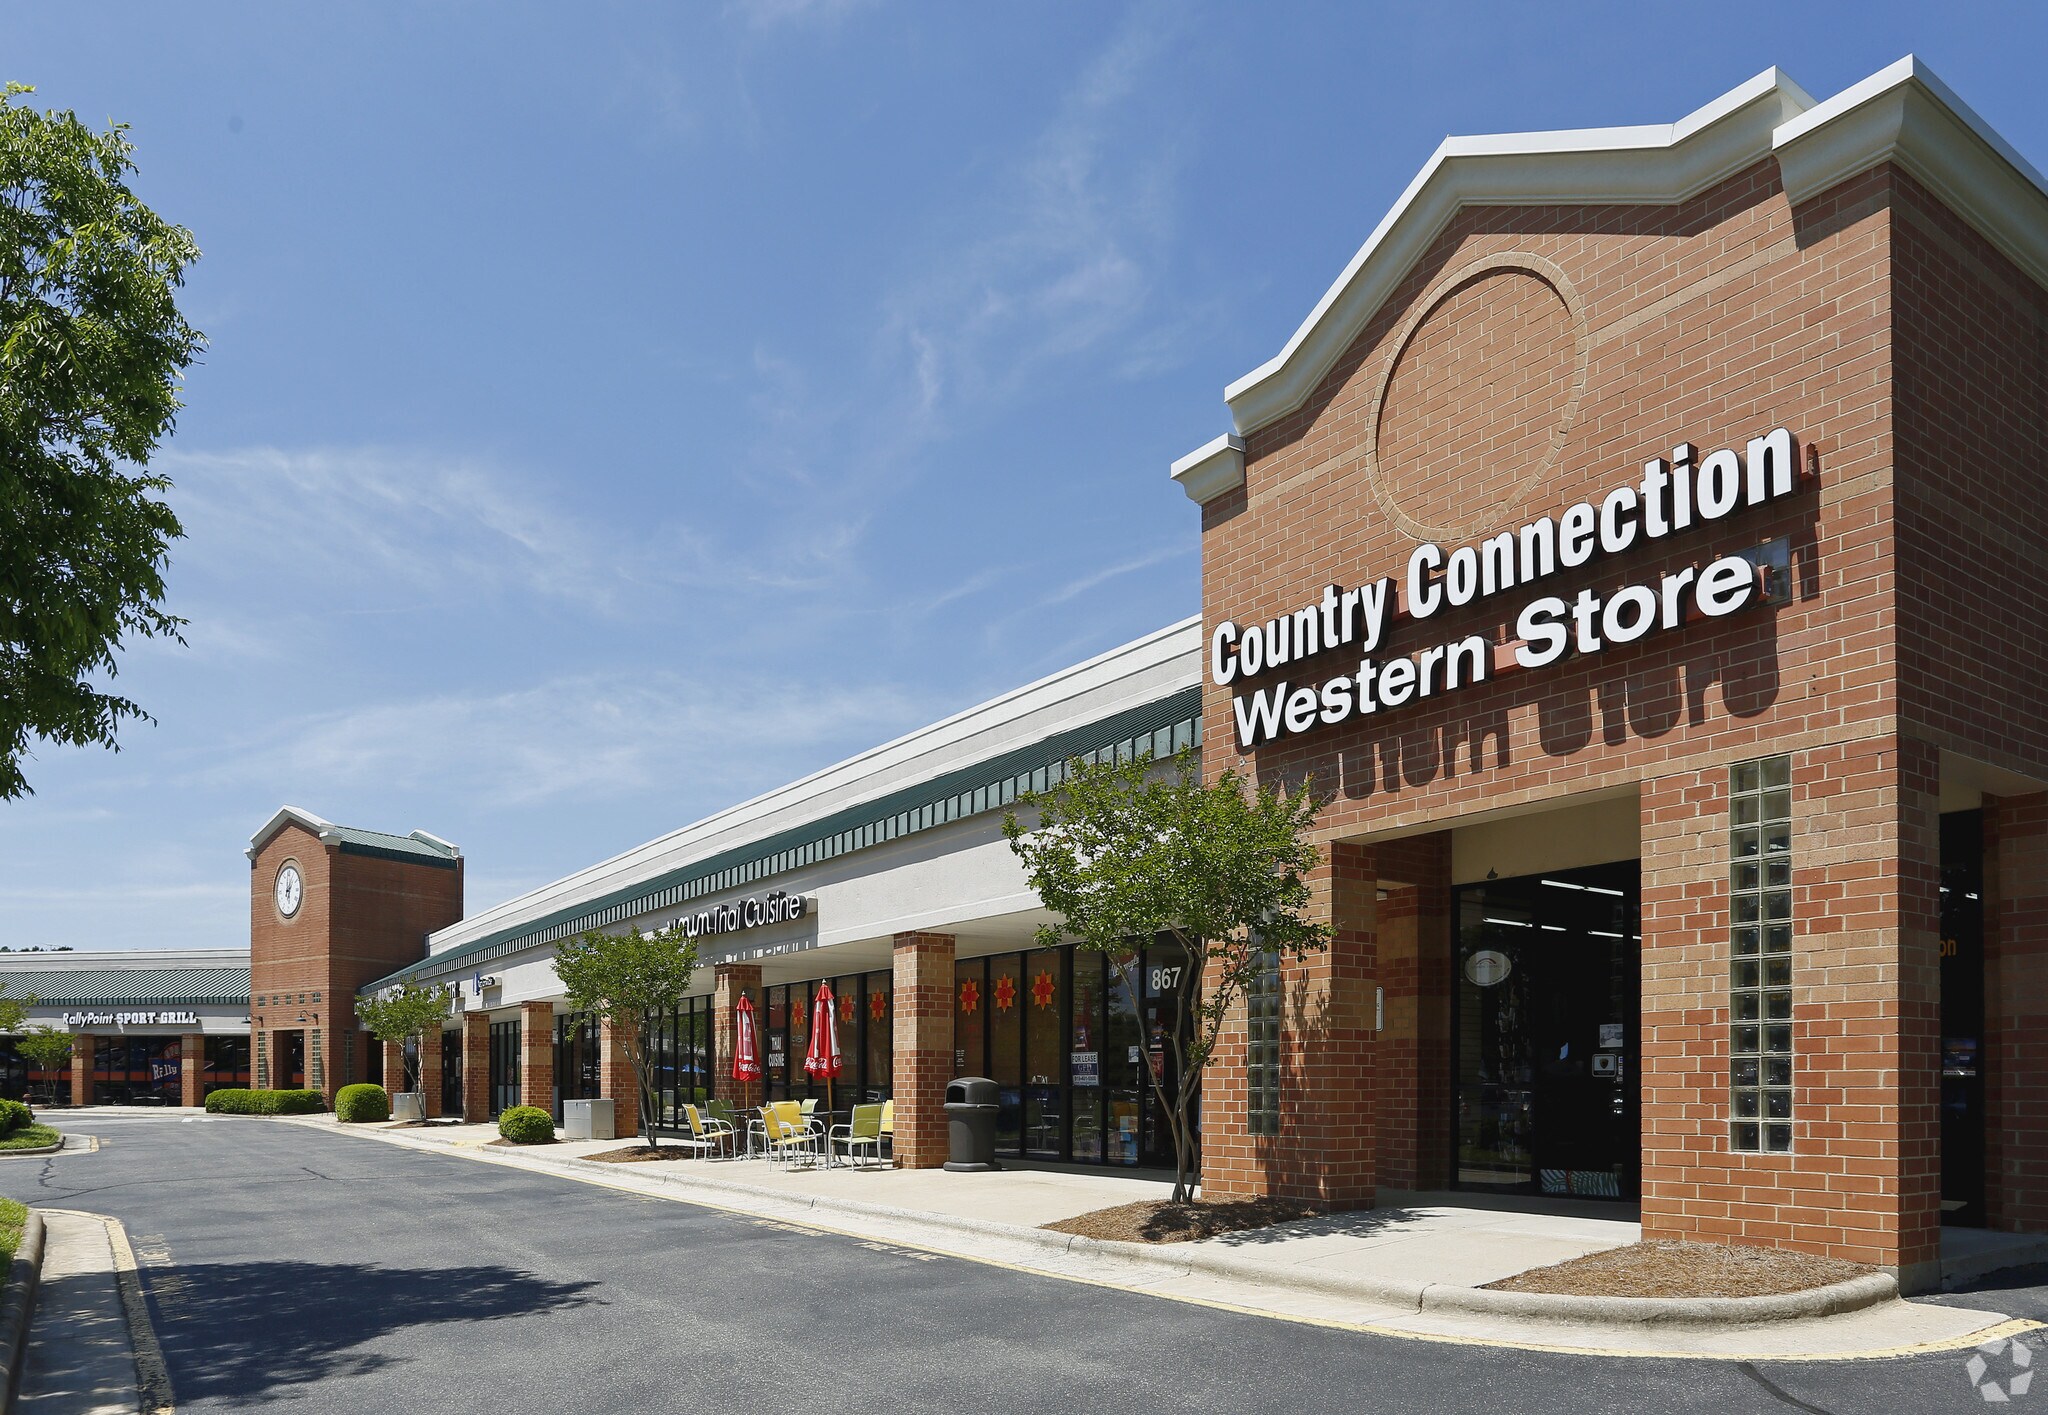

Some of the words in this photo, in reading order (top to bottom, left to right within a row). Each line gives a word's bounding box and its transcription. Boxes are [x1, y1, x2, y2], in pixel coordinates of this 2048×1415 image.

[1213, 576, 1389, 687] Country
[1407, 427, 1795, 620] Connection
[1233, 635, 1487, 748] Western
[1516, 555, 1756, 669] Store
[713, 902, 742, 935] Thai
[744, 891, 801, 929] Cuisine
[1151, 966, 1182, 991] 867
[62, 1011, 114, 1028] RallyPoint
[116, 1011, 156, 1025] SPORT
[159, 1011, 197, 1024] GRILL
[771, 1036, 782, 1051] THAI
[768, 1052, 785, 1067] CUISINE
[1072, 1055, 1081, 1063] FOR
[1082, 1054, 1097, 1063] LEASE
